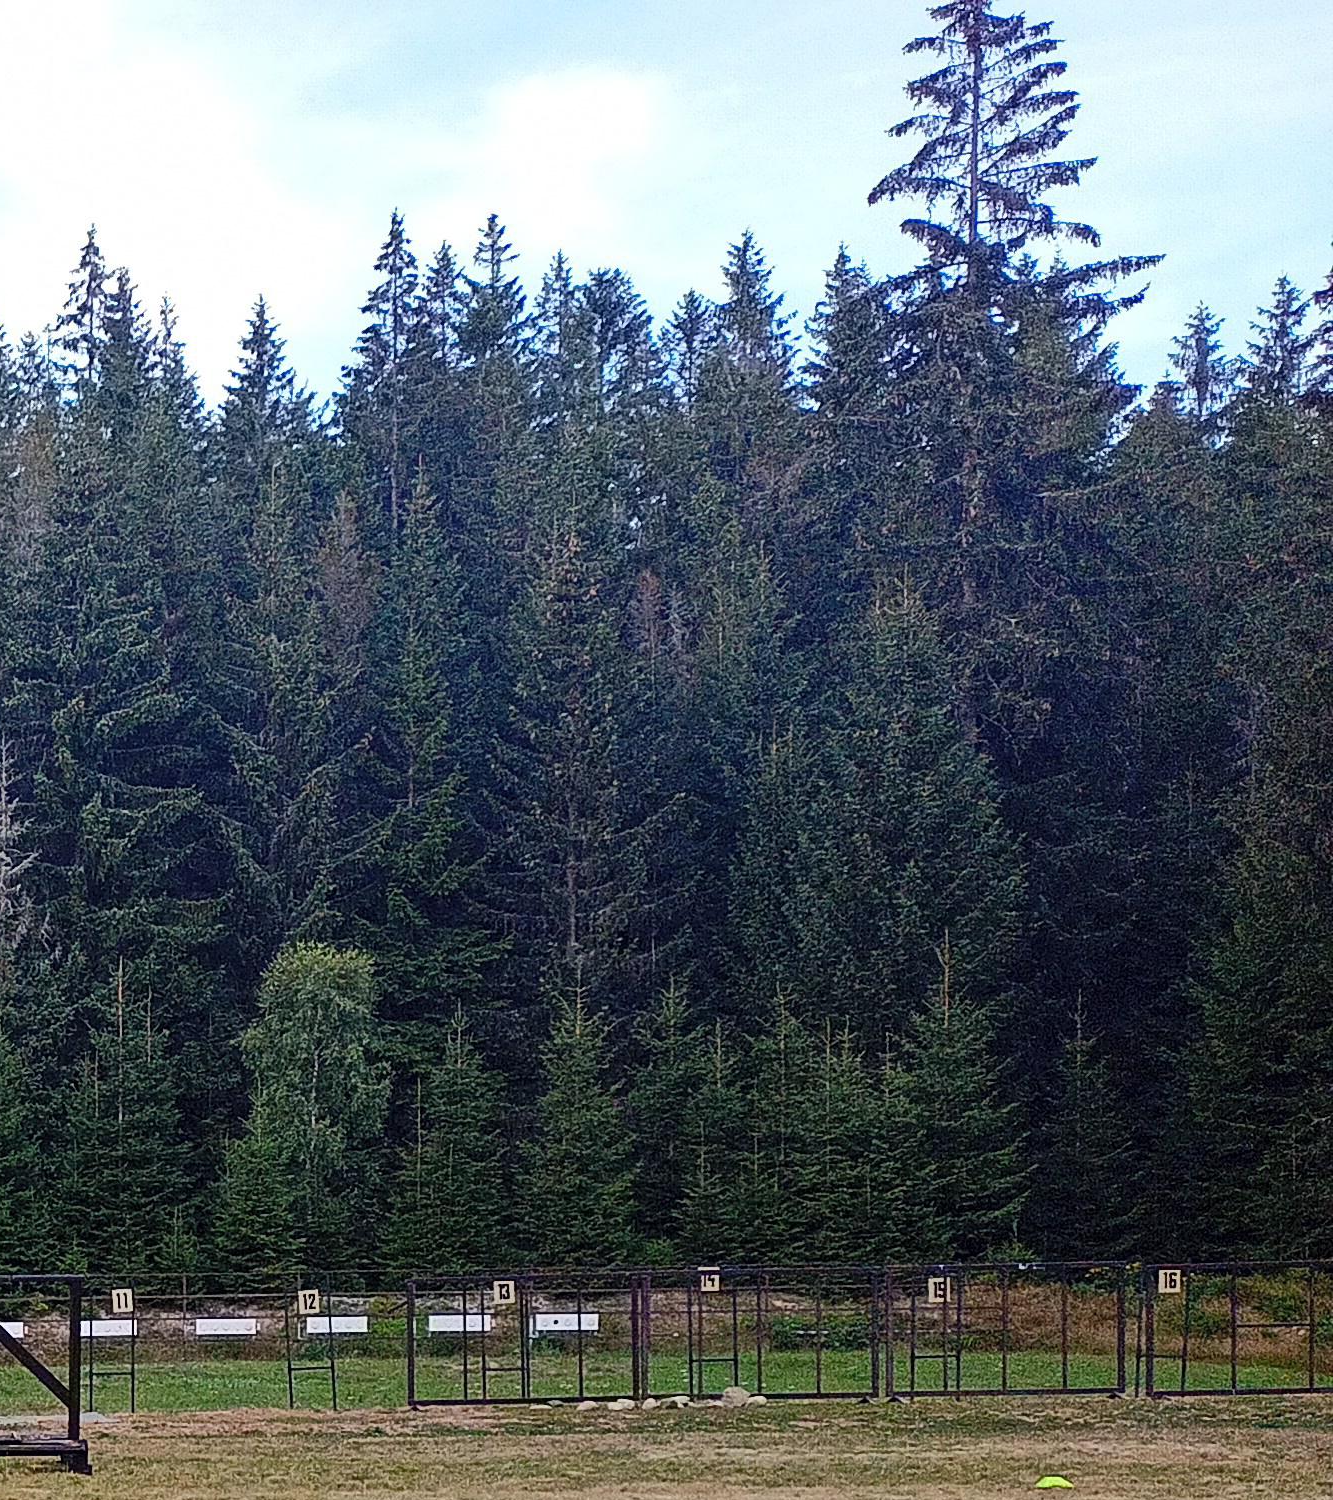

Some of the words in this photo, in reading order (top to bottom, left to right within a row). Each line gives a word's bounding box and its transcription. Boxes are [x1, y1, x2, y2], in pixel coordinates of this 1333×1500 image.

[703, 1273, 716, 1287] 14
[1163, 1272, 1177, 1289] 16
[116, 1292, 128, 1308] 11
[498, 1284, 510, 1300] 13
[302, 1294, 316, 1310] 12
